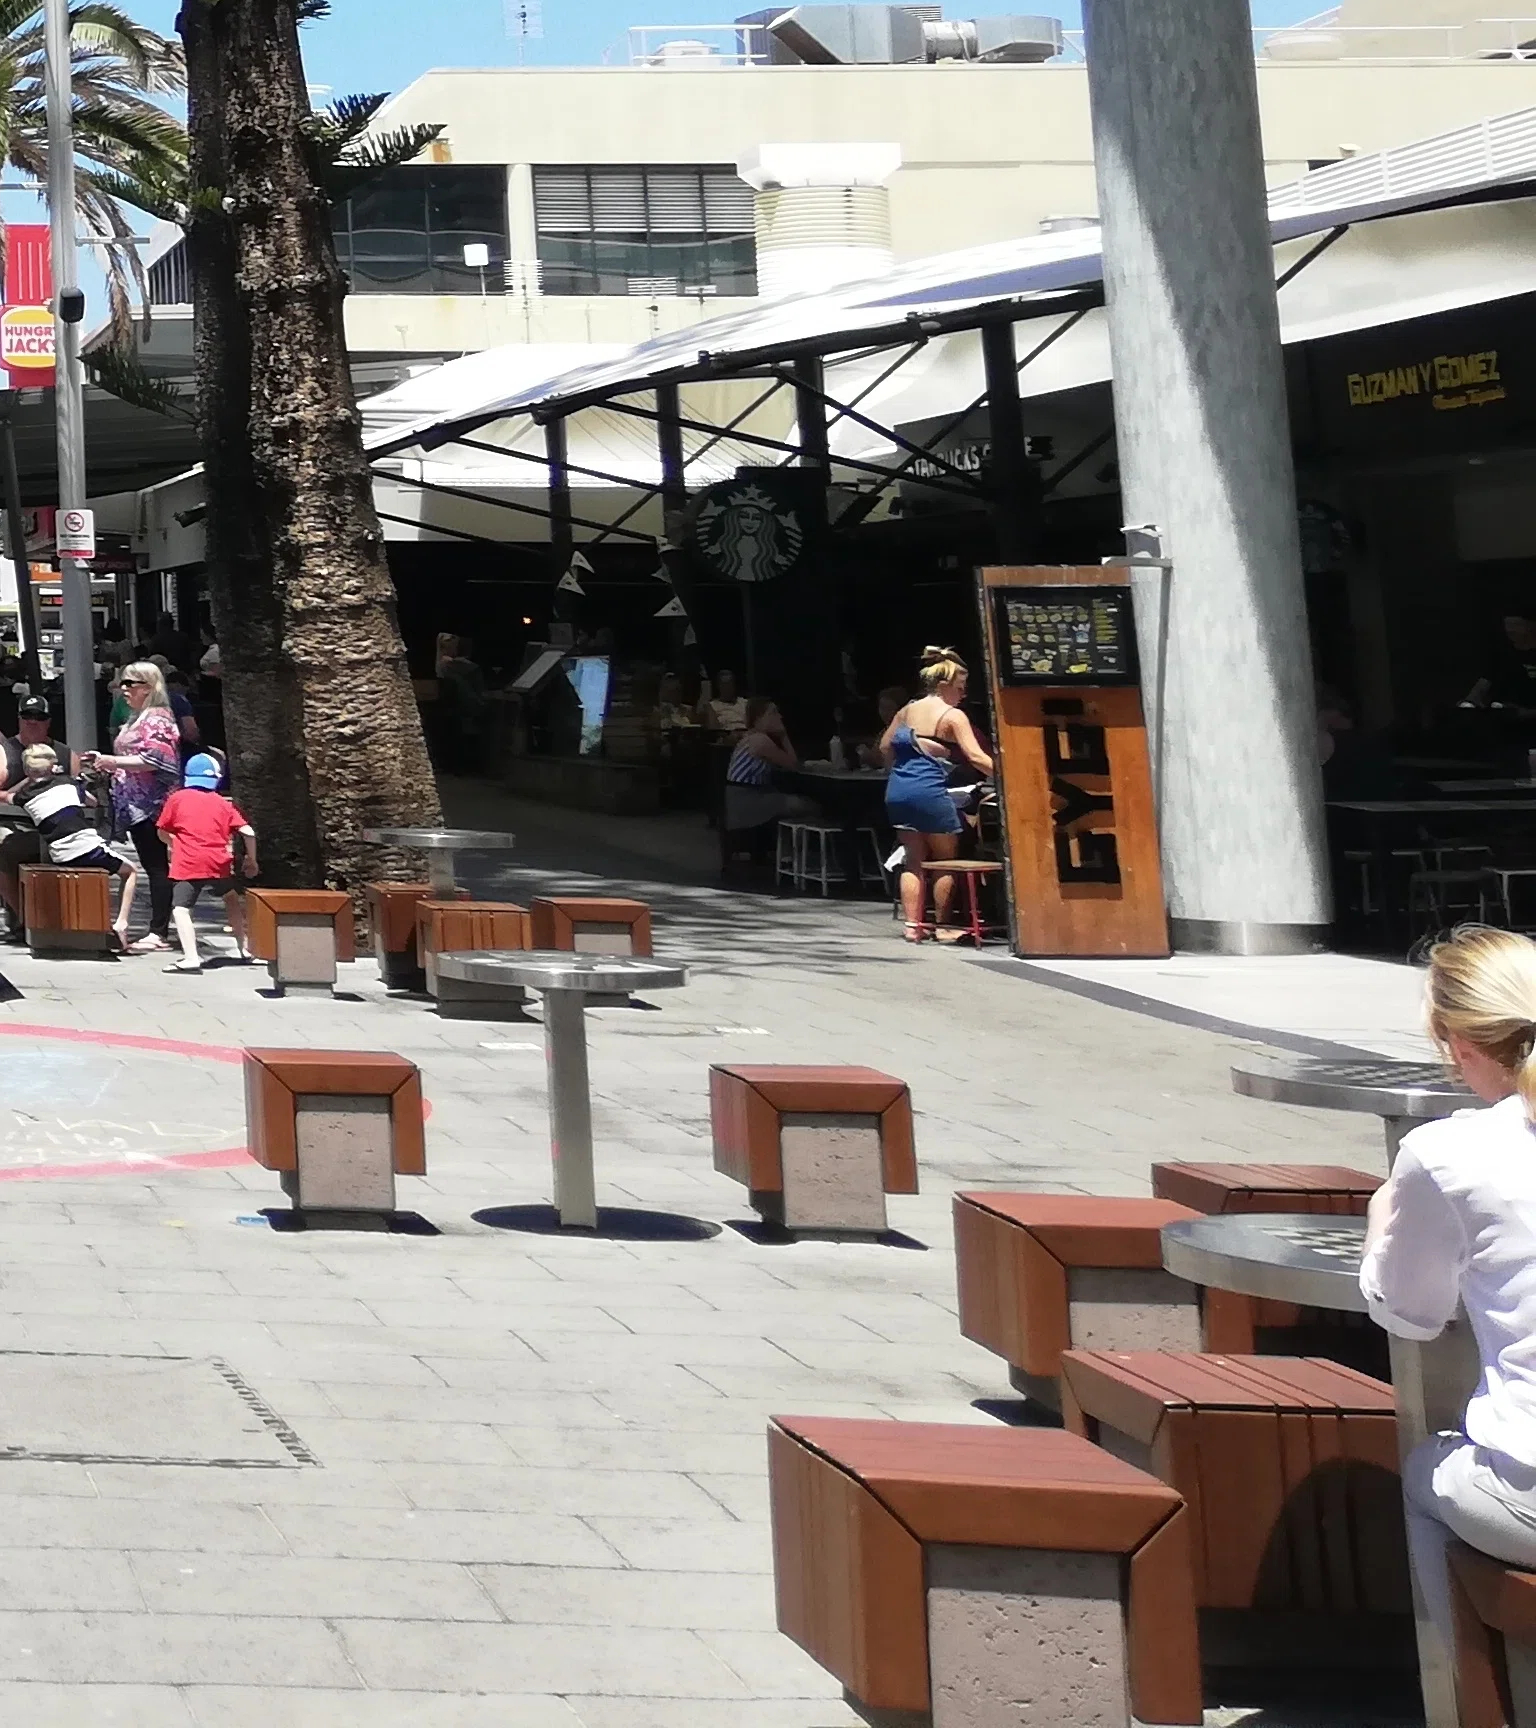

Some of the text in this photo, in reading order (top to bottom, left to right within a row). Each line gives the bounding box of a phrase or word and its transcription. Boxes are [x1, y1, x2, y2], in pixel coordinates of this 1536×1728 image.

[5, 325, 56, 336] HUNGR
[1347, 367, 1420, 405] GUZMAN
[1419, 361, 1431, 392] Y
[1433, 350, 1501, 389] GOMEZ
